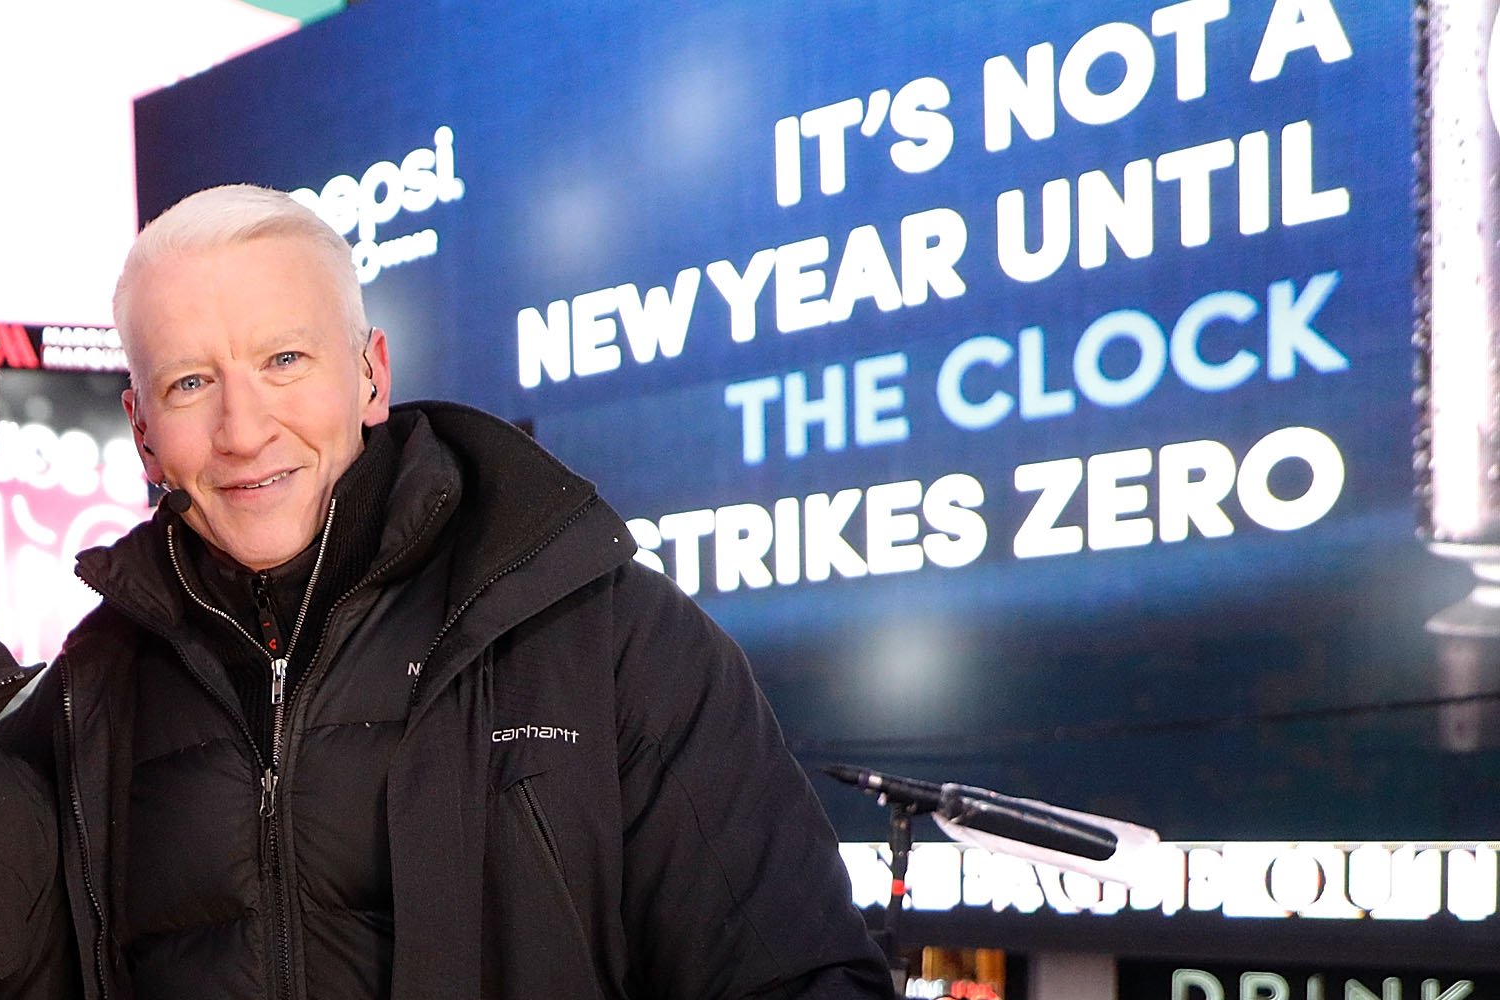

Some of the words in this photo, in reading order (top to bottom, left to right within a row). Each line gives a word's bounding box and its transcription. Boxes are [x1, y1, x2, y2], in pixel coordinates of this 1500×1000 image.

[774, 77, 954, 208] IT'S
[983, 0, 1230, 151] NOT
[1250, 0, 1352, 83] A
[42, 326, 122, 348] MARRIO
[517, 267, 701, 388] NEW
[704, 208, 967, 343] YEAR
[996, 120, 1350, 283] UNTIL
[724, 353, 908, 464] THE
[936, 271, 1350, 430] CLOCK
[624, 473, 988, 597] STRIKES
[1013, 426, 1345, 559] ZERO
[491, 723, 581, 745] carhartt
